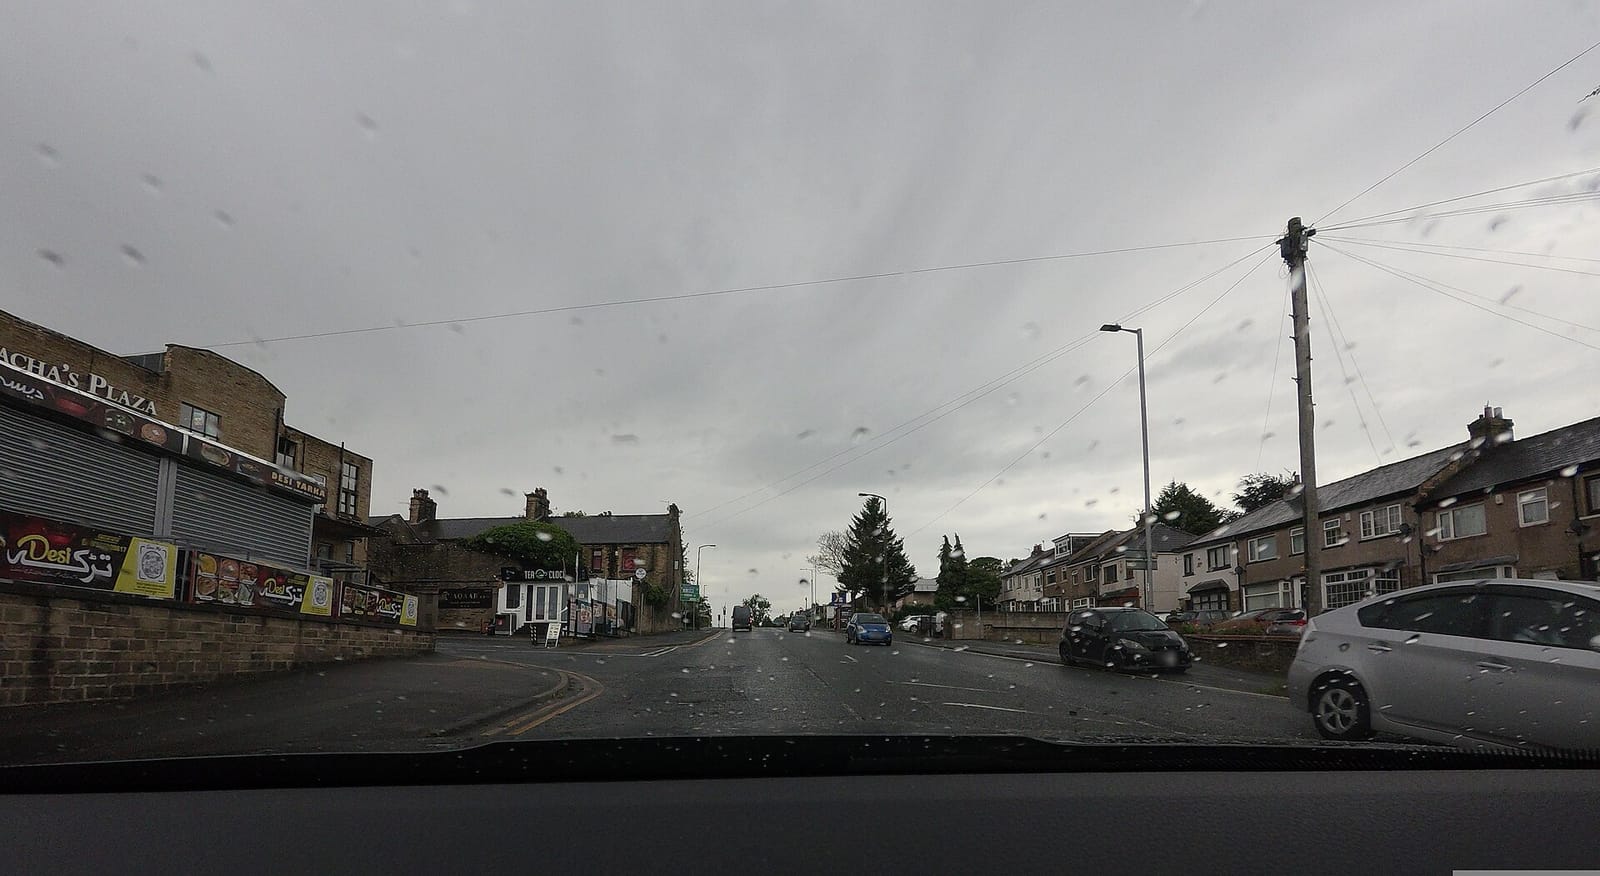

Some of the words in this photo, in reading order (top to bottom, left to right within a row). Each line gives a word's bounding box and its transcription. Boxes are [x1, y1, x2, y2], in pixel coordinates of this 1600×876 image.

[87, 372, 158, 416] PLAZA
[271, 471, 293, 486] DESI
[17, 534, 72, 564] Desi
[524, 569, 535, 580] TEA
[263, 578, 286, 595] Desi
